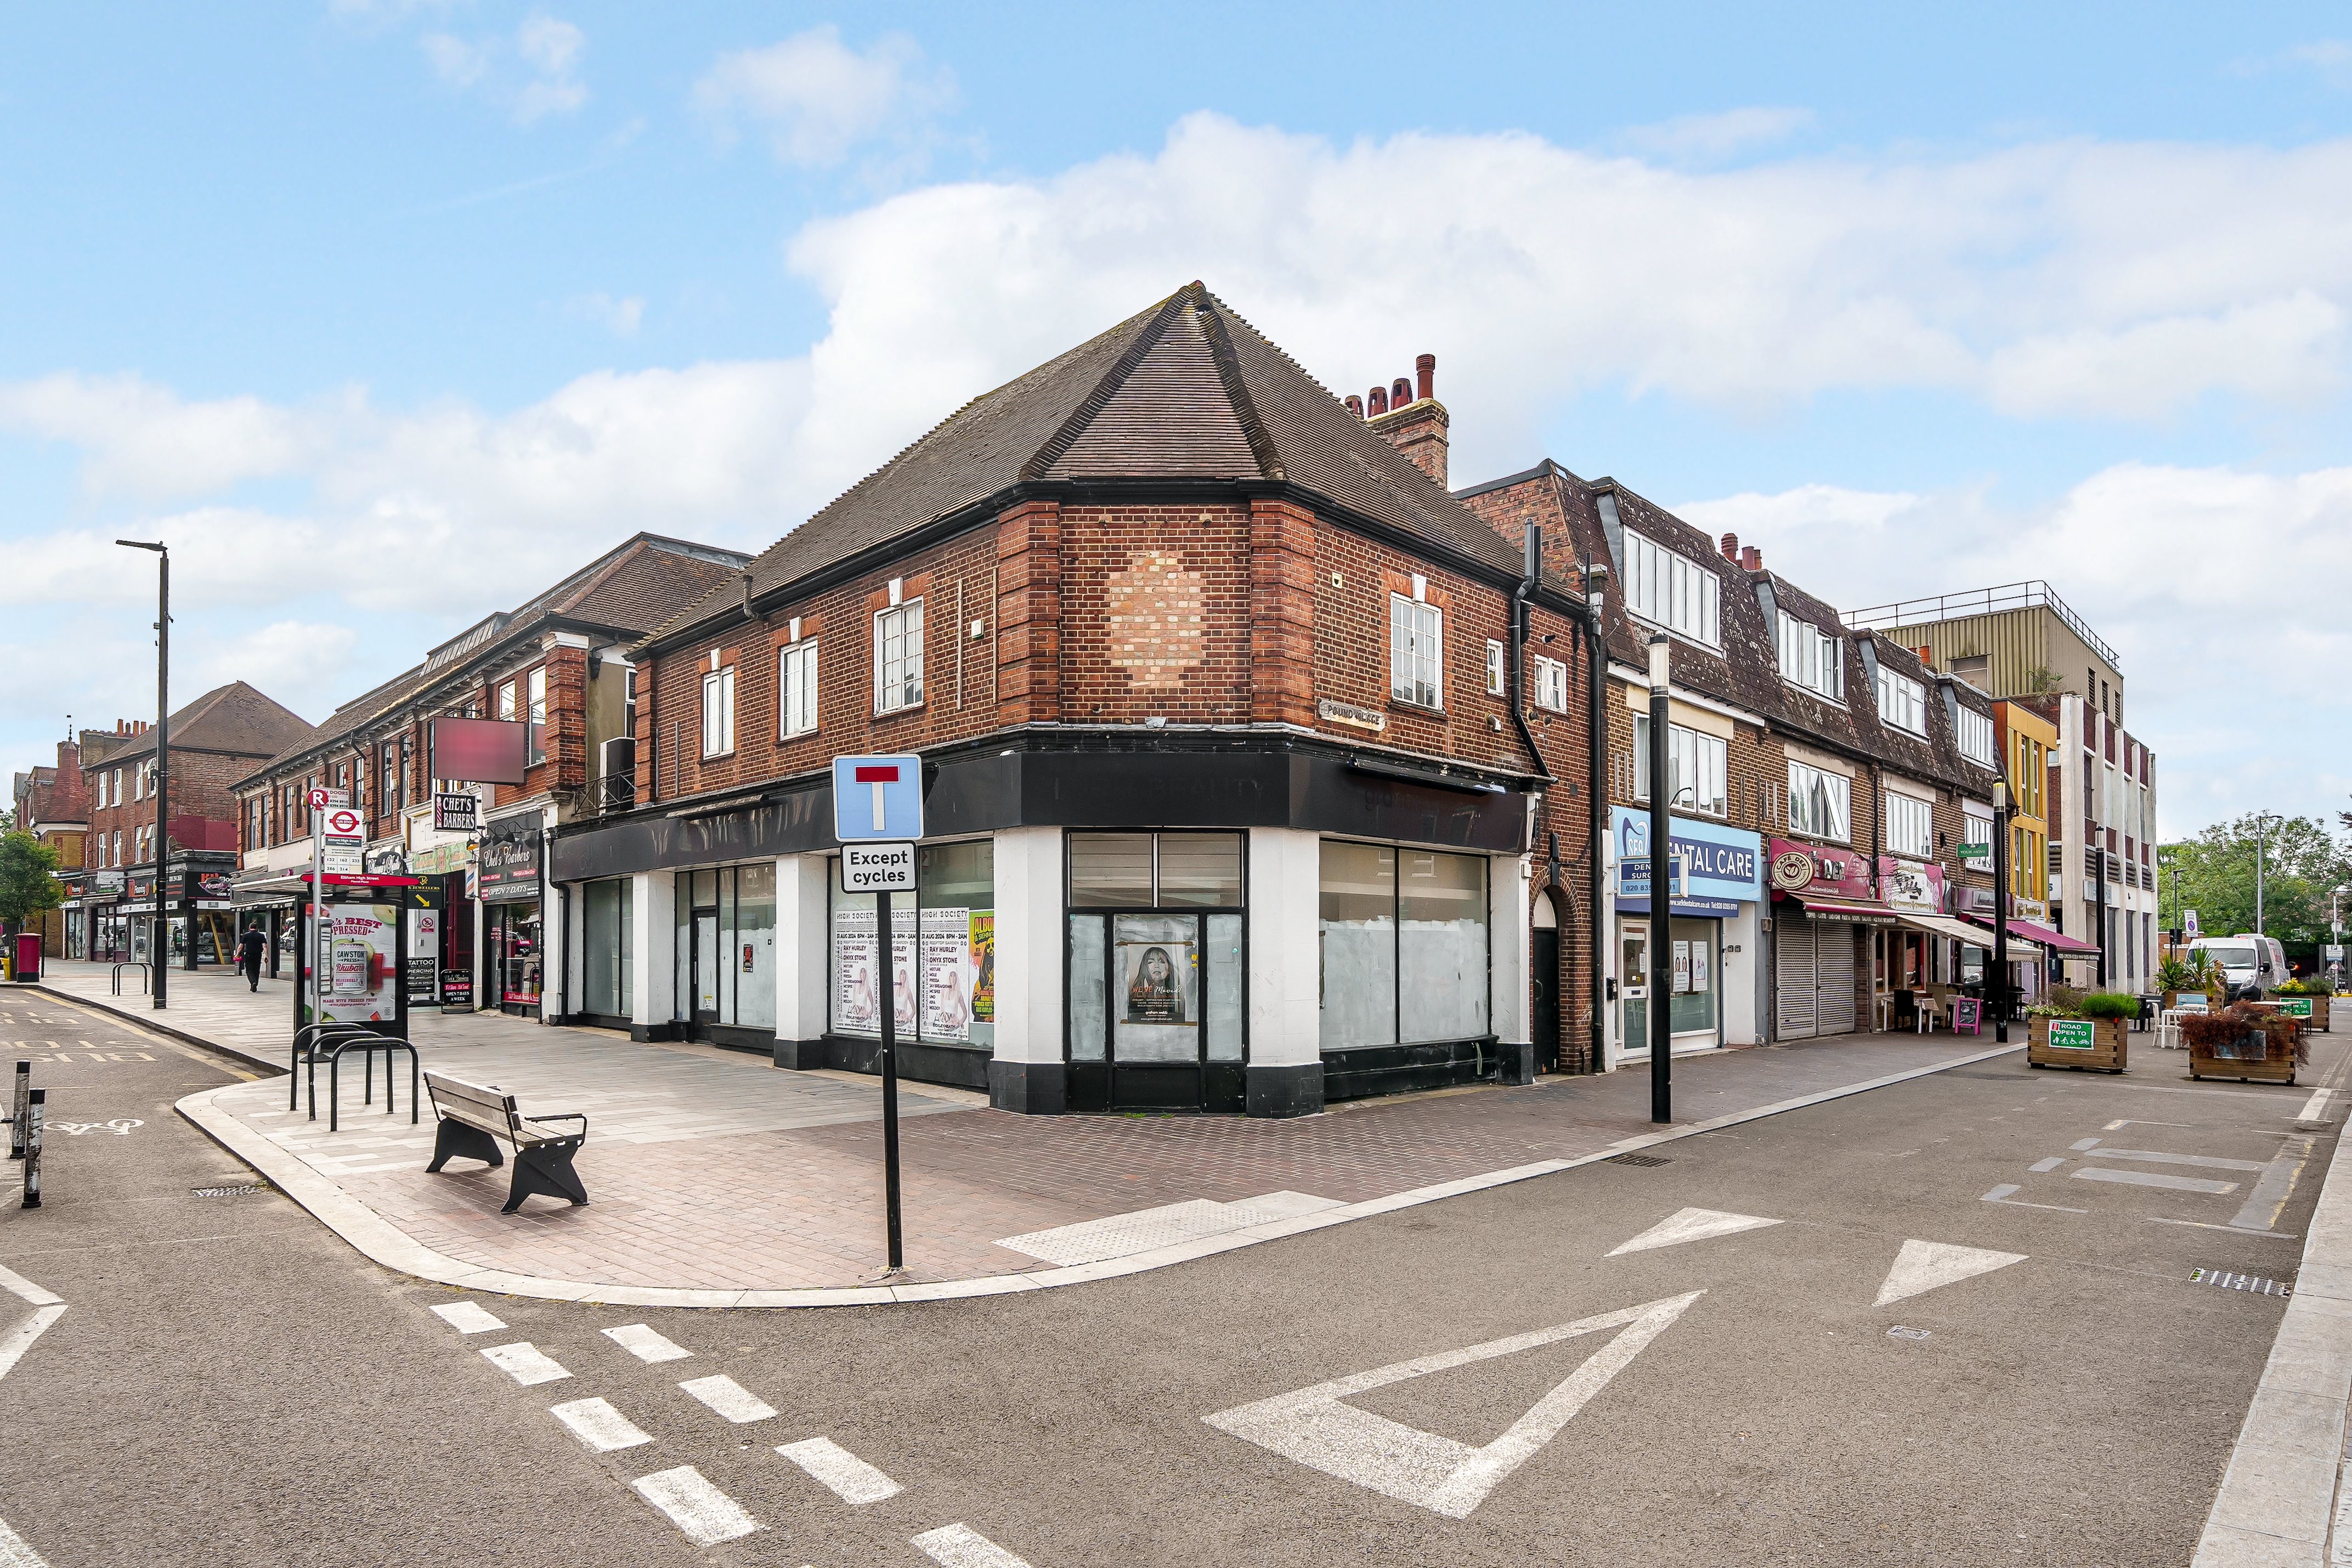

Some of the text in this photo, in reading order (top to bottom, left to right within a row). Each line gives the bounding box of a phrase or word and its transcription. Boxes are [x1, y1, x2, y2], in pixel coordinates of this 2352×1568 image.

[1328, 705, 1380, 725] POUND PLACE
[313, 791, 325, 805] R
[443, 797, 472, 812] CHET'S
[443, 812, 474, 829] BARBERS
[1628, 838, 1643, 856] SE9
[483, 848, 503, 868] Chet's
[503, 844, 531, 864] Barbers
[850, 850, 908, 866] Except
[1716, 849, 1753, 878] CARE
[1777, 854, 1807, 870] CAFÉ DEE
[853, 869, 906, 885] cycles
[510, 885, 528, 893] DAYS
[333, 926, 368, 936] PRESSED
[345, 918, 382, 929] BEST
[1155, 984, 1182, 994] Moved!
[922, 1009, 925, 1020] UK
